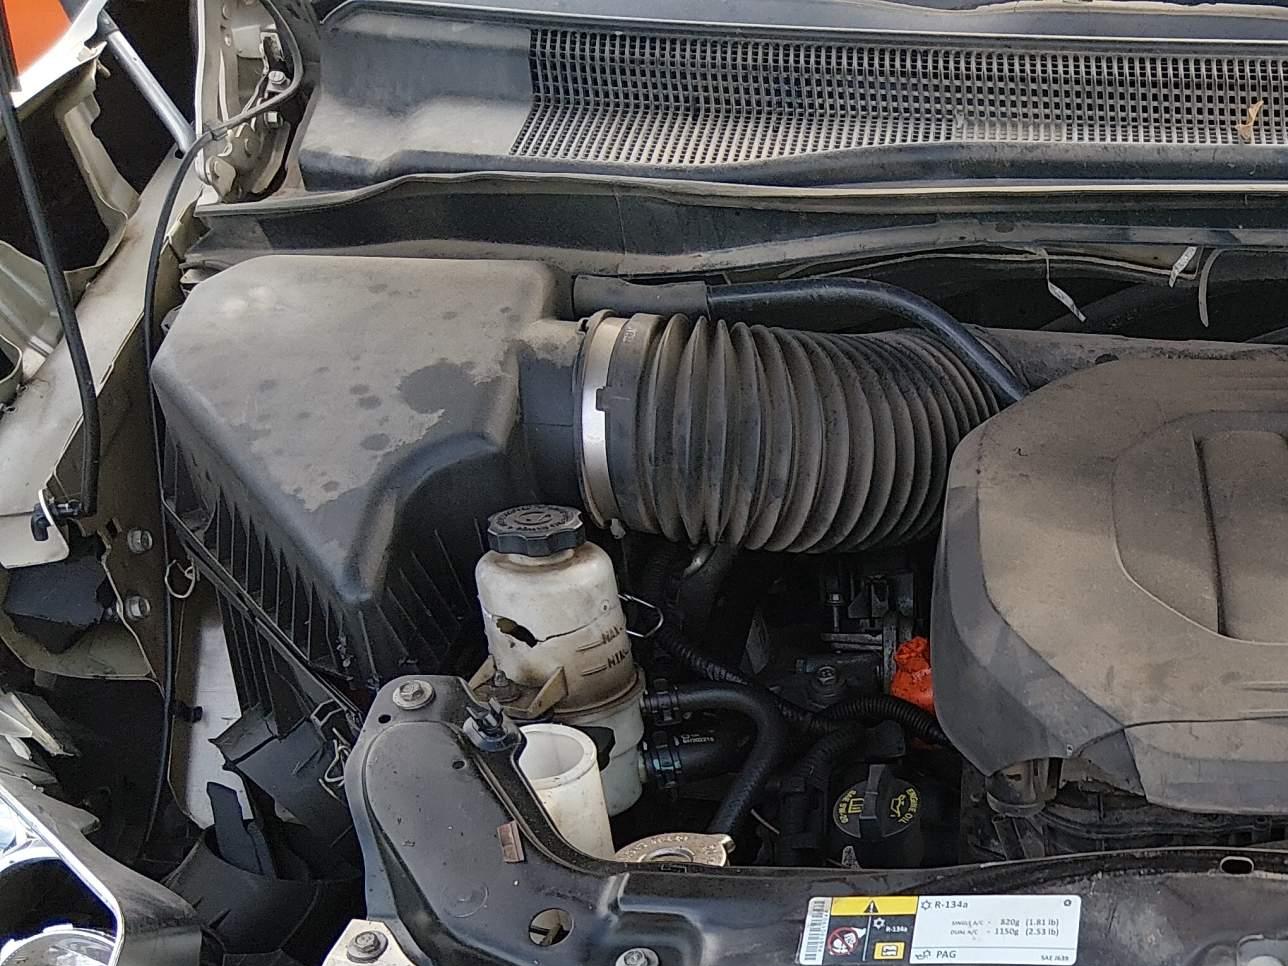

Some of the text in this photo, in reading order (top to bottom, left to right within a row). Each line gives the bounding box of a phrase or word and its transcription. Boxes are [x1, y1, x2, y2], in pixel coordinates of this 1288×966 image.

[898, 812, 914, 824] OIL
[934, 900, 969, 909] R-134a
[1000, 918, 1020, 928] 820g
[1047, 918, 1060, 928] lb)
[994, 928, 1020, 937] 1150g
[1025, 928, 1046, 938] (2.53
[1047, 928, 1060, 938] lb)
[936, 950, 957, 959] PAG
